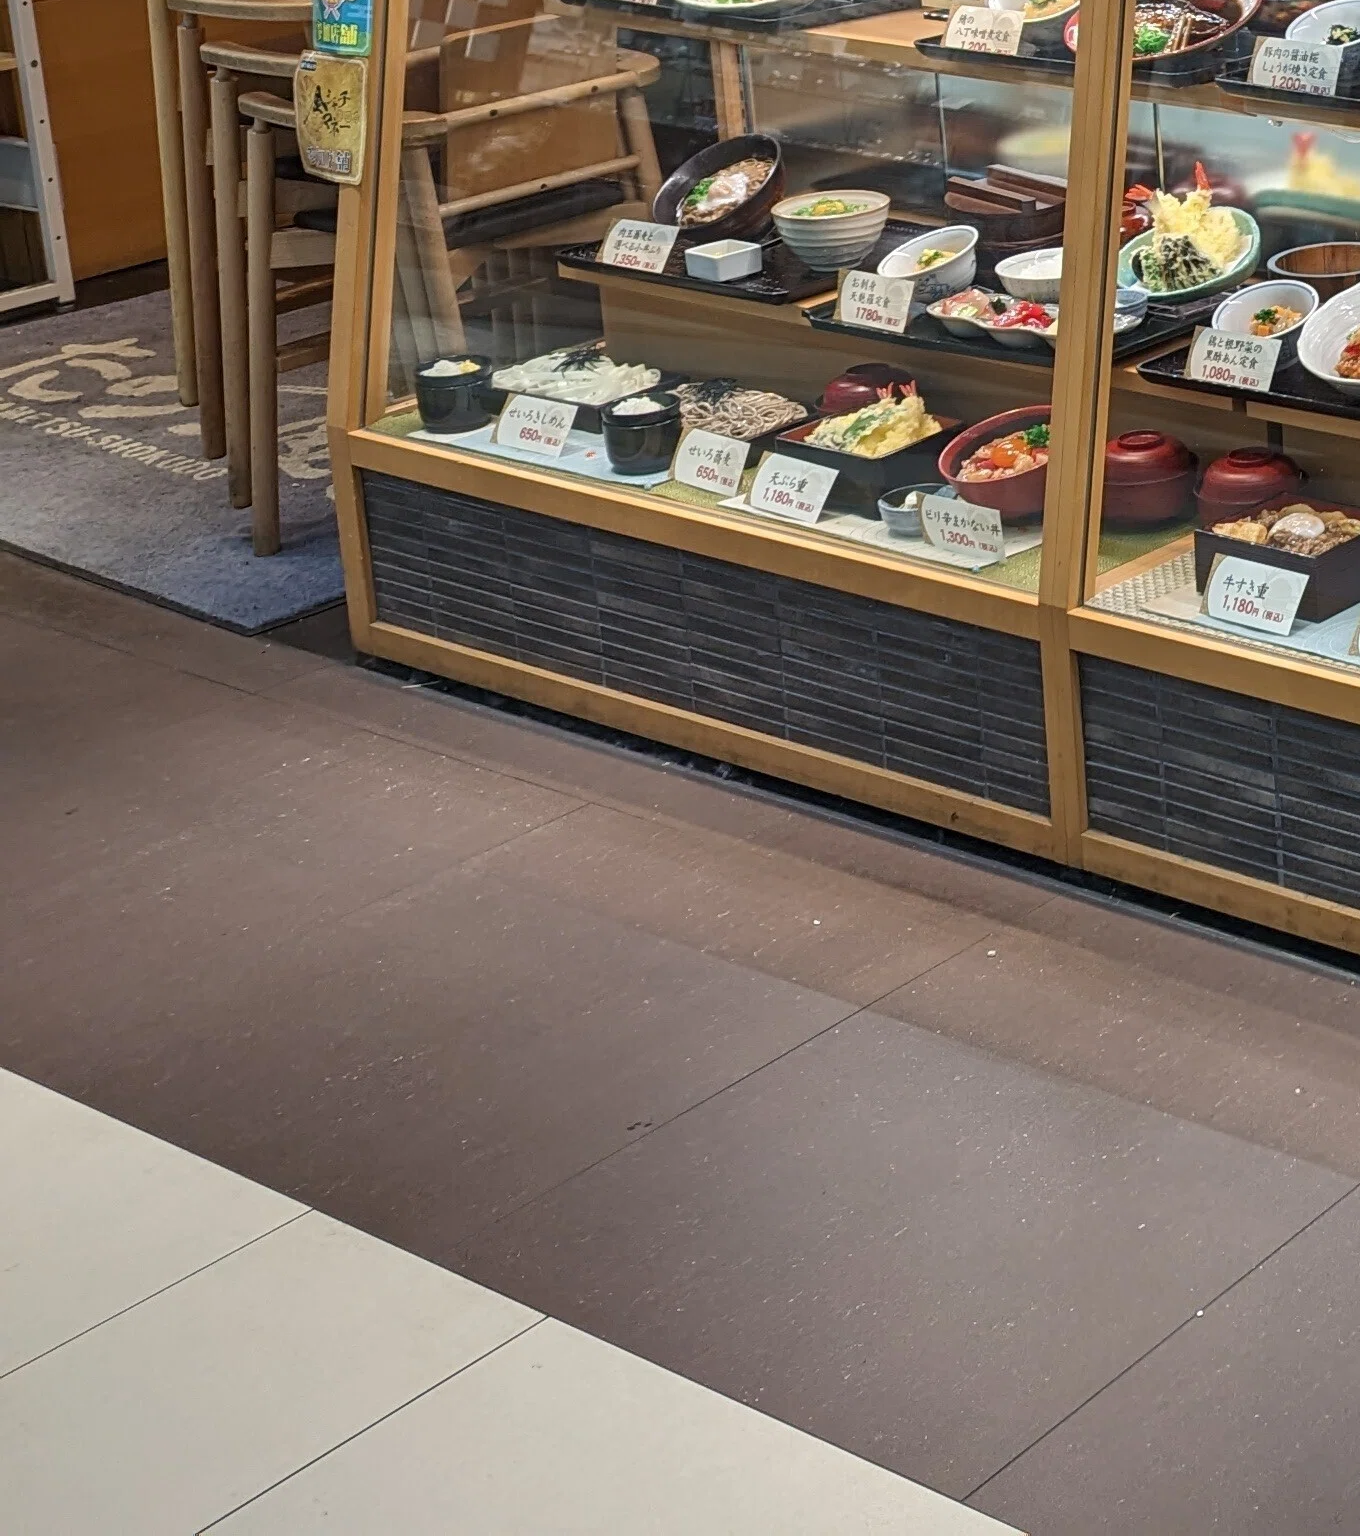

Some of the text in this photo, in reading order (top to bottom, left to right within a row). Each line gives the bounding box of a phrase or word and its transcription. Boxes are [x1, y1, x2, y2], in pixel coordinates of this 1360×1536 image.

[1262, 62, 1328, 81] しょうが焼き定食
[851, 277, 877, 292] お刺身
[1208, 334, 1263, 354] 鶏と根野菜の
[1203, 349, 1259, 370] 黒酢あん定食
[508, 407, 567, 429] せいろきしめん
[688, 444, 732, 467] せいろ蕎麦
[925, 509, 1000, 537] ピリ辛まかない丼
[1222, 574, 1270, 600] 牛すき重
[1222, 594, 1284, 623] 1,180円（税込）
